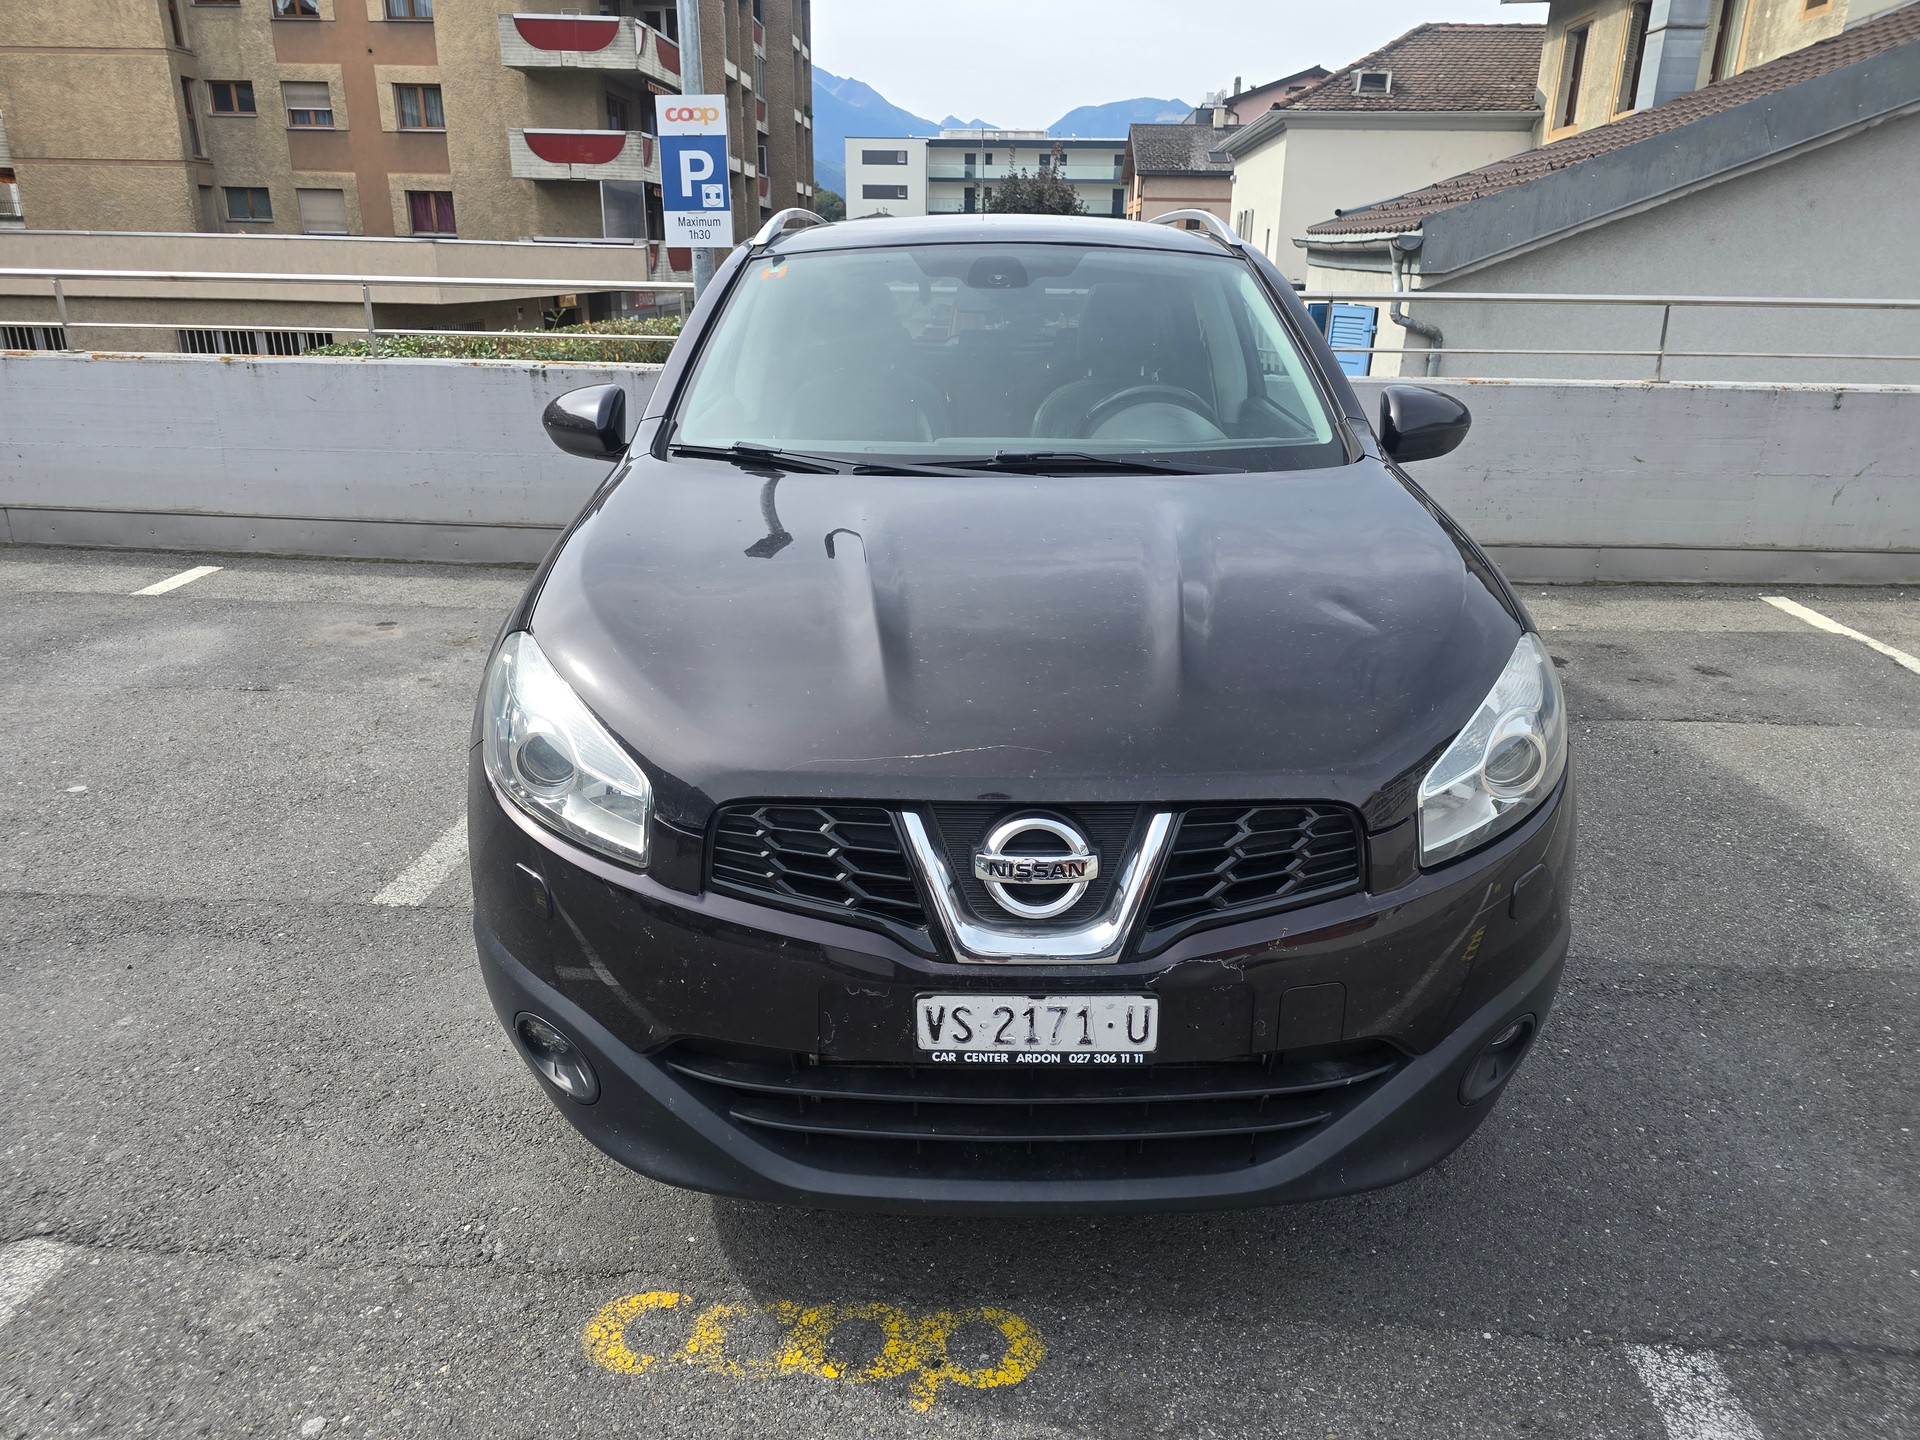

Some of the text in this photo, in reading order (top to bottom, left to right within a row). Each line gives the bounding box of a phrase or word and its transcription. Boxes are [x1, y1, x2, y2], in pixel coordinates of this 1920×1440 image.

[665, 107, 719, 125] coop
[679, 150, 714, 197] P
[678, 216, 721, 227] Maximum
[689, 230, 711, 240] 1h30
[988, 861, 1085, 879] NISSAN
[932, 1052, 1144, 1064] CAR CENTER ARDON 027 306 11 11
[582, 1291, 1046, 1413] coop
